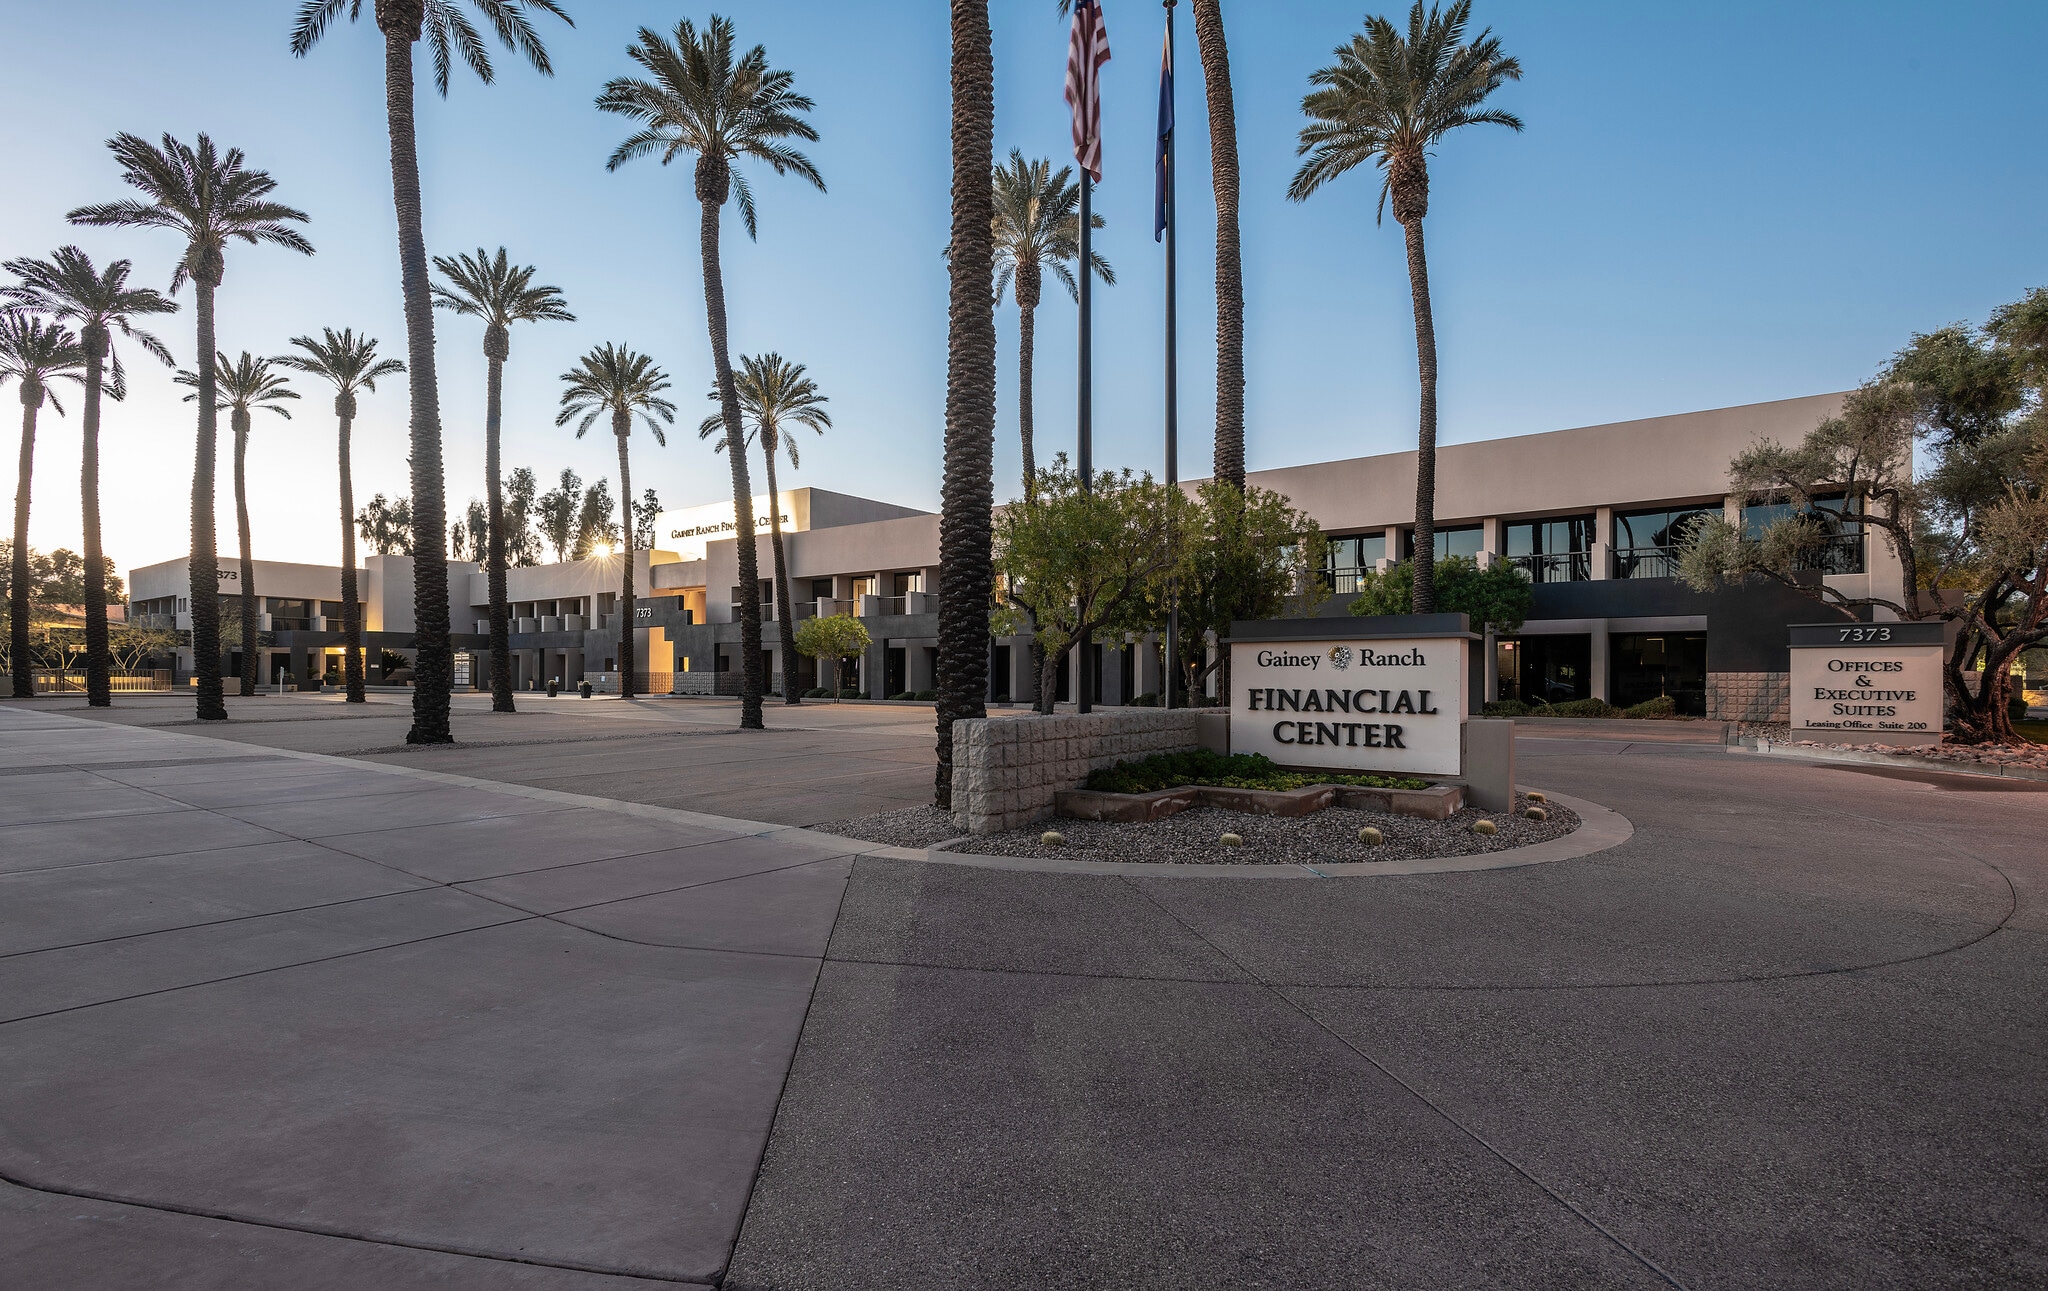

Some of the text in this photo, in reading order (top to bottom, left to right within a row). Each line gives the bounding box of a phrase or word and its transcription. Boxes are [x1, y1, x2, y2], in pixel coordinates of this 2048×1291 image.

[695, 525, 720, 536] RANCH
[758, 514, 789, 527] CEER
[216, 570, 238, 580] 373
[636, 607, 652, 618] 7373
[1839, 627, 1891, 642] 7373
[1257, 647, 1426, 670] Gainey Ranch
[1827, 659, 1903, 672] OFFICES
[1855, 674, 1874, 687] &
[1814, 687, 1916, 701] EXECUTIVE
[1248, 688, 1437, 715] FINANCIAL
[1833, 702, 1896, 717] SUITES
[1805, 719, 1927, 730] Leasing Office Suite 200
[1272, 720, 1406, 749] CENTER
